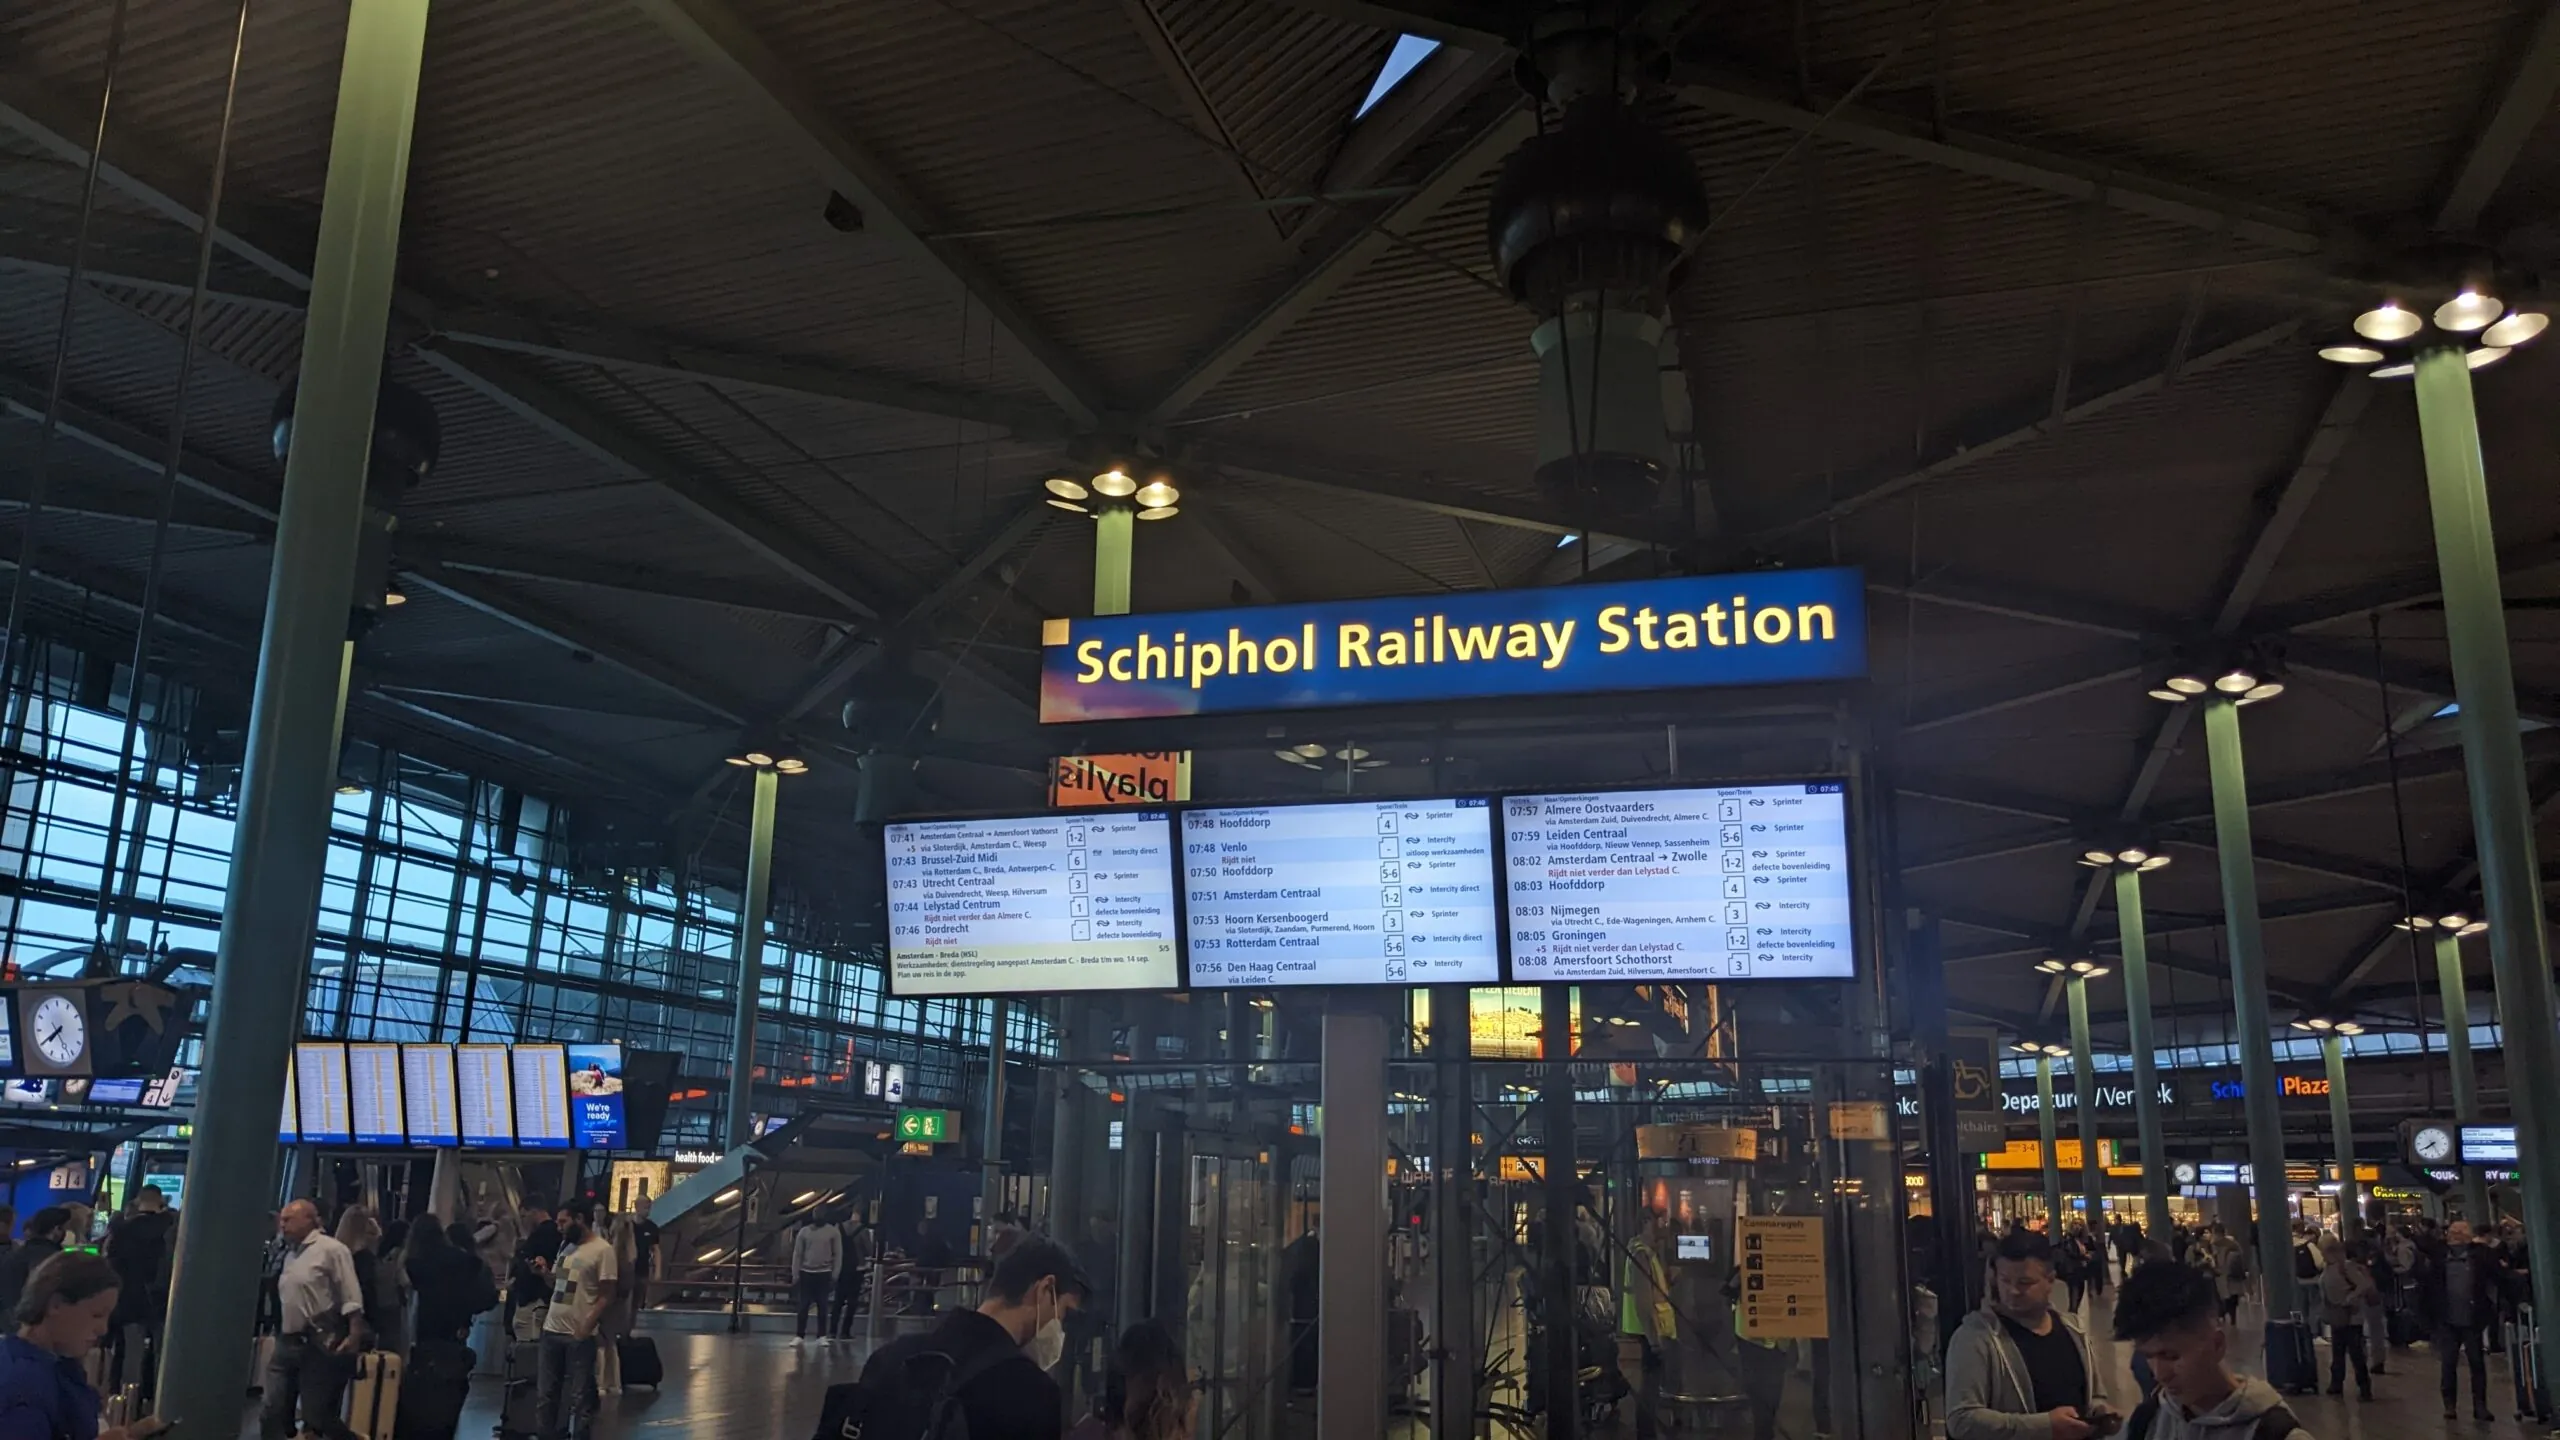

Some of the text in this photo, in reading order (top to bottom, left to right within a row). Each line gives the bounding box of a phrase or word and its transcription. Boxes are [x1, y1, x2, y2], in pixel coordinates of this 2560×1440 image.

[1076, 596, 1836, 689] Schiphol Railway Station
[1820, 784, 1838, 794] 07:40
[1772, 798, 1802, 806] Sprinter
[1510, 805, 1538, 816] 07:57
[1545, 802, 1654, 815] Almere Oostvaarders
[1727, 806, 1733, 816] 3
[1426, 812, 1453, 820] Sprinter
[1558, 817, 1599, 825] Amsterdam
[1673, 813, 1700, 821] Almere
[1188, 819, 1214, 829] 07:48
[1220, 817, 1271, 829] Hoofddorp
[1384, 820, 1391, 829] 4
[1774, 824, 1804, 832] Sprinter
[891, 833, 914, 843] 07:41
[920, 832, 956, 840] Amsterdam
[957, 831, 984, 839] Centraal
[993, 829, 1030, 837] Amersfoort
[1070, 832, 1083, 842] 1-2
[1511, 831, 1540, 842] 07:59
[1546, 828, 1627, 840] Leiden Centraal
[1723, 832, 1740, 843] 5-6
[1427, 836, 1456, 844] Intercity
[1605, 841, 1630, 849] Nieuw
[1664, 838, 1710, 847] Sassenheim
[1189, 843, 1216, 854] 07:48
[1221, 842, 1248, 852] Venlo
[1431, 848, 1484, 856] werkzaamheden
[921, 852, 998, 865] Brussel-Zuid Midi
[1548, 850, 1707, 865] Amsterdam Centraal Zwolle
[1776, 850, 1805, 858] Sprinter
[892, 856, 916, 866] 07:43
[1074, 856, 1080, 866] 6
[1221, 856, 1256, 866] Rijdt niet
[1429, 861, 1456, 869] Sprinter
[1513, 856, 1541, 867] 08:02
[1725, 857, 1741, 869] 1-2
[1222, 865, 1273, 878] Hoofddorp
[1752, 862, 1830, 871] defecte bovenleiding
[1190, 867, 1217, 878] 07:50
[1382, 868, 1398, 879] 5-6
[1548, 869, 1568, 879] Rijdt
[1569, 869, 1586, 879] niet
[1587, 868, 1615, 876] verder
[1617, 868, 1633, 876] dan
[1635, 866, 1670, 877] Lelystad
[893, 879, 917, 889] 07:43
[922, 876, 995, 888] Utrecht Centraal
[1076, 879, 1081, 889] 3
[1549, 878, 1605, 891] Hoofddorp
[1777, 875, 1807, 884] Sprinter
[1430, 884, 1480, 894] Intercity direct
[1514, 881, 1543, 891] 08:03
[1731, 884, 1738, 893] 4
[1191, 891, 1217, 901] 07:51
[1223, 887, 1321, 900] Amsterdam Centraal
[1385, 893, 1399, 903] 1-2
[894, 902, 919, 912] 07:44
[924, 899, 1001, 913] Lelystad Centrum
[1077, 903, 1081, 912] 1
[1515, 906, 1544, 916] 08:03
[1551, 904, 1600, 918] Nijmegen
[1779, 902, 1810, 910] Intercity
[1225, 912, 1329, 926] Hoorn Kersenboogerd
[1431, 910, 1458, 918] Sprinter
[1733, 909, 1739, 919] 3
[1193, 915, 1219, 925] 07:53
[1390, 917, 1396, 927] 3
[1564, 916, 1593, 925] Utrecht
[1675, 915, 1706, 923] Arnhem
[895, 925, 920, 935] 07:46
[925, 921, 969, 934] Dordrecht
[1353, 923, 1375, 931] Hoorn
[1517, 931, 1546, 941] 08:05
[1552, 929, 1606, 943] Groningen
[1780, 928, 1812, 937] Intercity
[1194, 939, 1221, 949] 07:53
[1226, 936, 1319, 948] Rotterdam Centraal
[1433, 935, 1461, 943] Intercity
[1730, 935, 1746, 946] 1-2
[1387, 942, 1402, 952] 5-6
[1553, 944, 1572, 955] Rijdt
[1574, 945, 1590, 955] niet
[1592, 944, 1619, 952] verder
[1621, 944, 1637, 952] dan
[1639, 943, 1674, 953] Lelystad
[1518, 956, 1547, 966] 08:08
[1553, 953, 1672, 965] Amersfoort Schothorst
[1782, 954, 1813, 962] Intercity
[1195, 963, 1222, 973] 07:56
[1227, 961, 1316, 974] Den Haag Centraal
[1434, 960, 1463, 968] Intercity
[1736, 961, 1742, 971] 3
[1388, 966, 1403, 977] 5-6
[2283, 1076, 2331, 1096] Plaza
[586, 1103, 610, 1112] We're
[587, 1112, 610, 1121] ready
[675, 1150, 697, 1162] health
[698, 1151, 715, 1164] food
